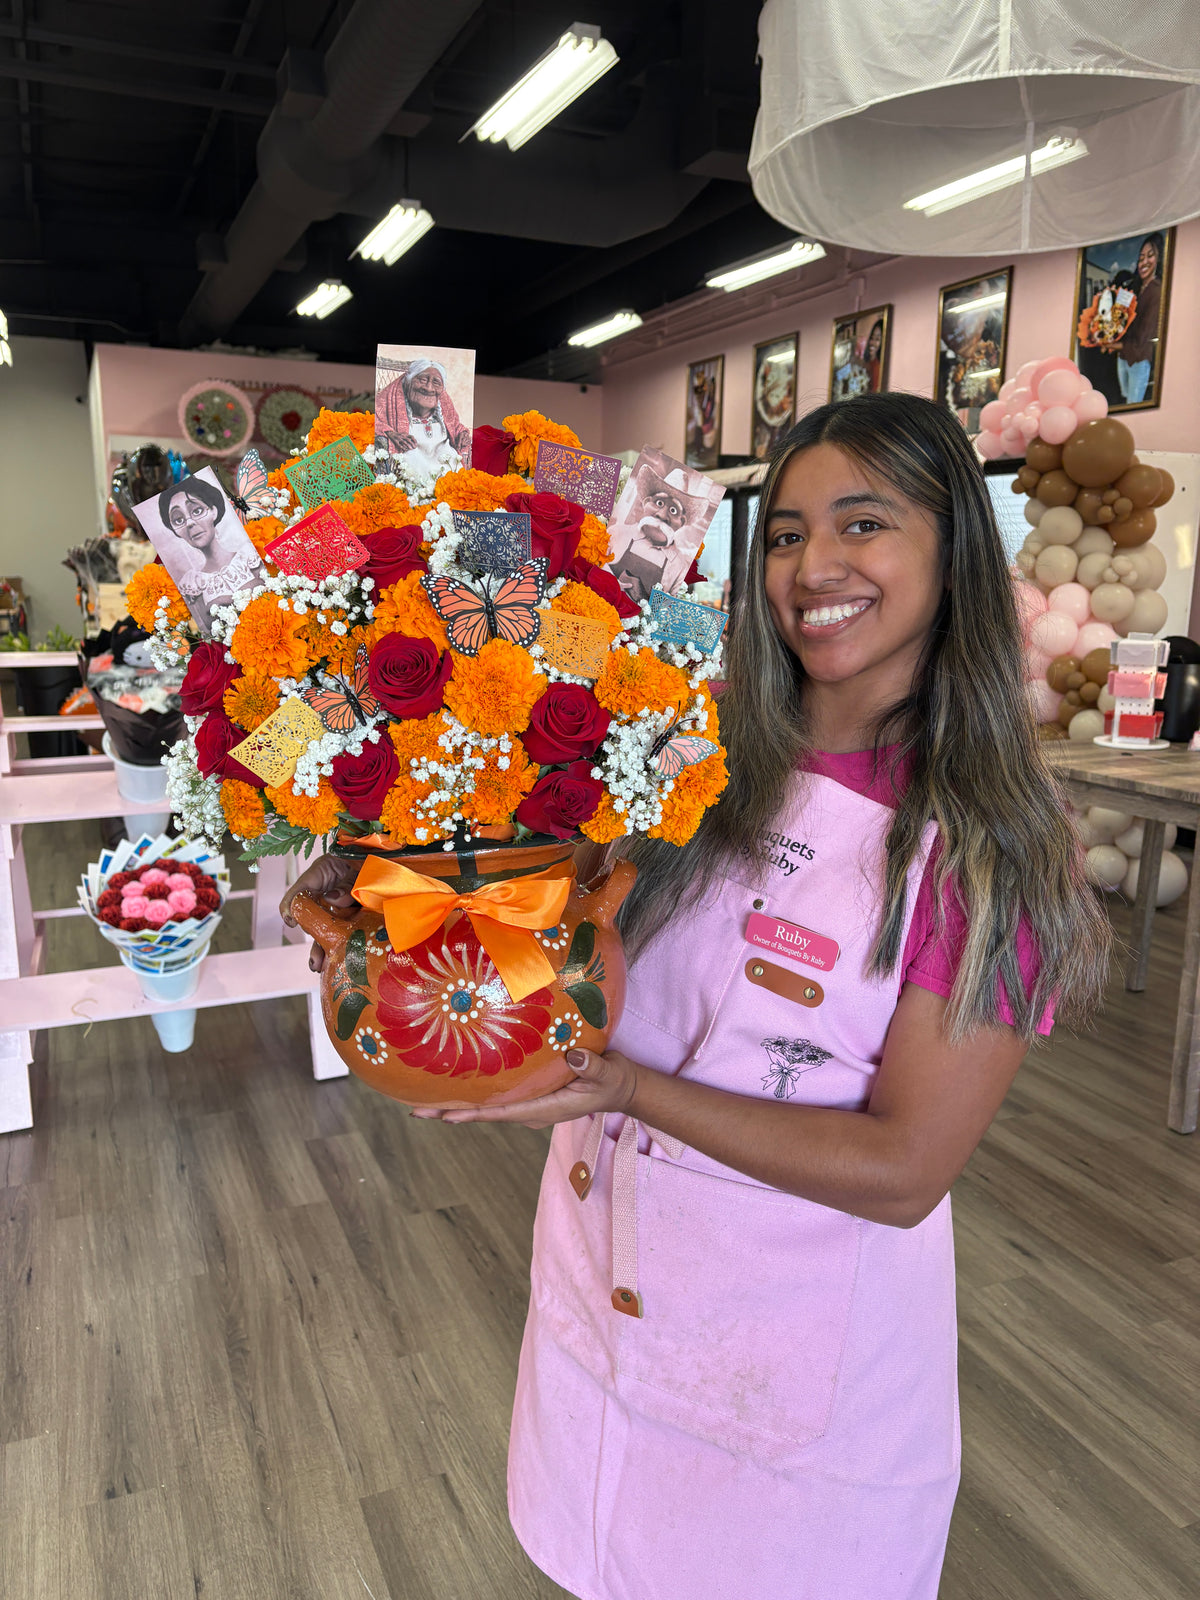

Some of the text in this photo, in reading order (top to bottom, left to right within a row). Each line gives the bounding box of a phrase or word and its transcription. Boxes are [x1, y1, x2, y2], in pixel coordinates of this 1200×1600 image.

[762, 830, 816, 861] quets
[753, 934, 826, 967] Owner of Bouquets By Ruby
[775, 925, 811, 951] Ruby
